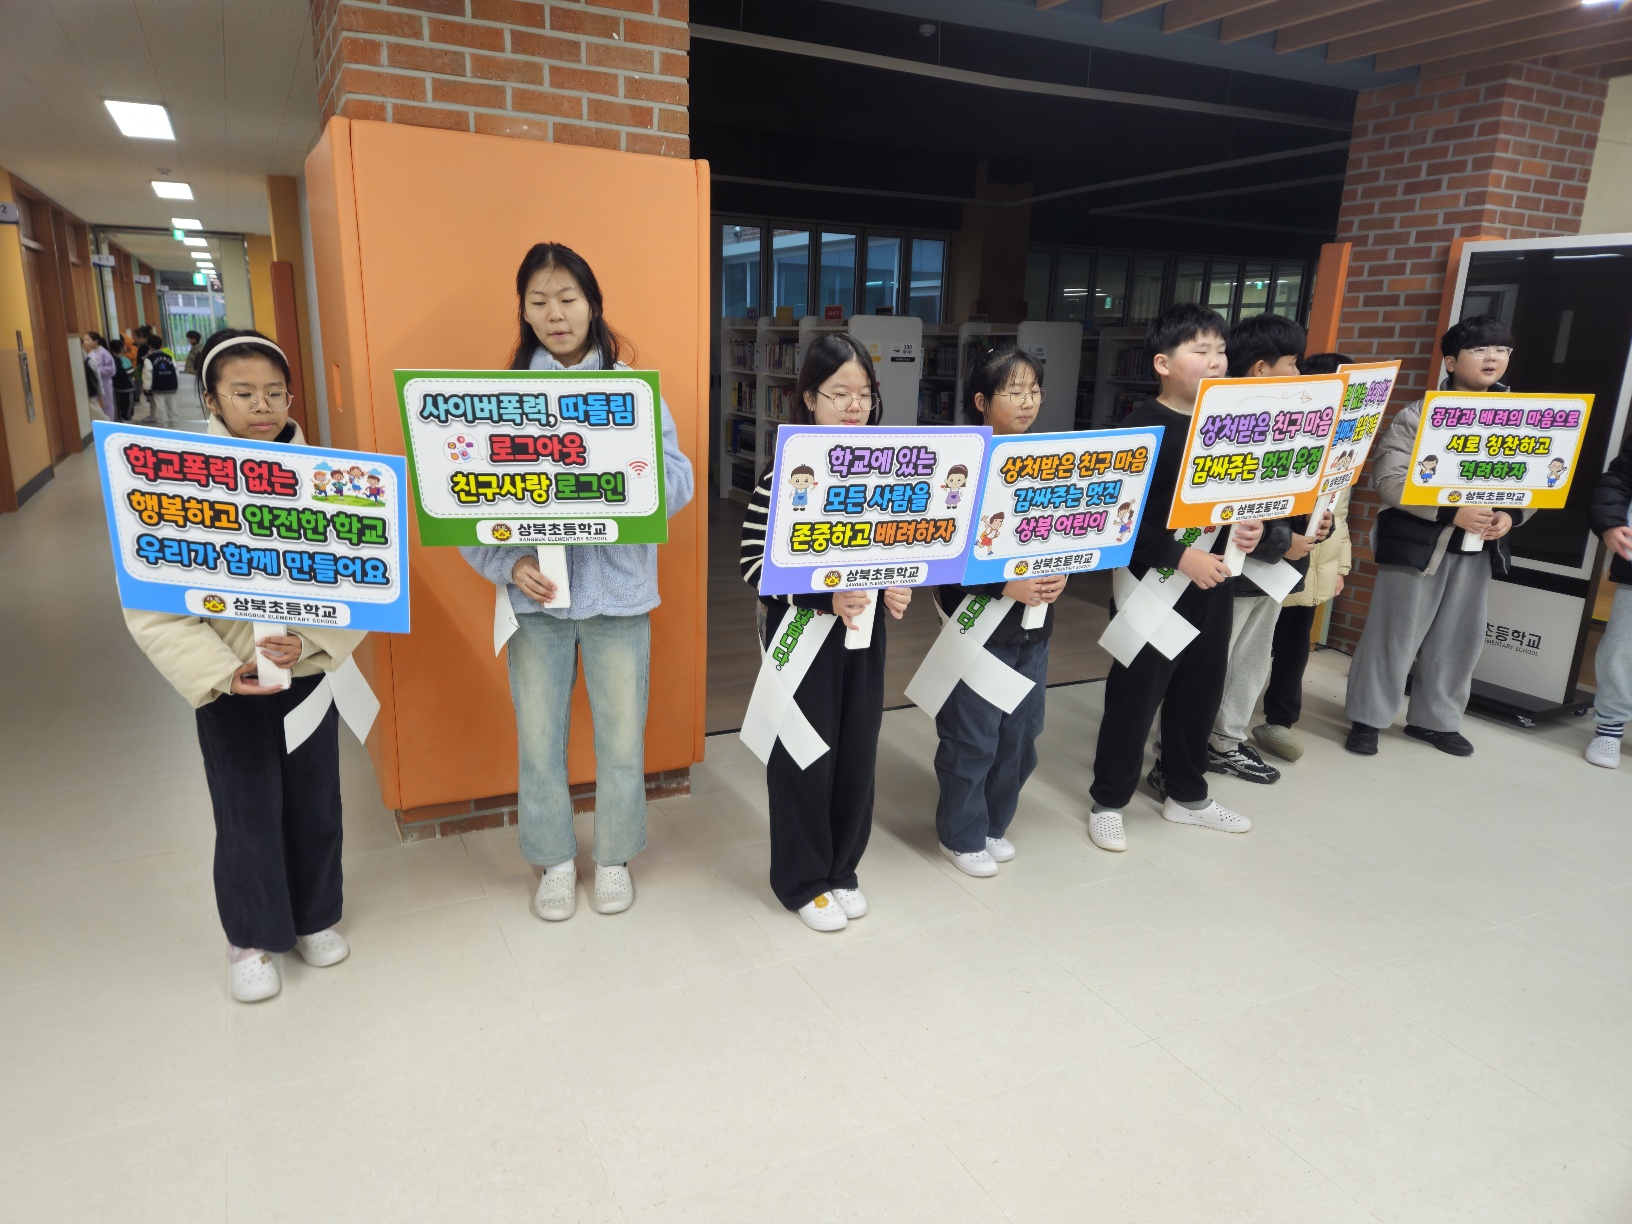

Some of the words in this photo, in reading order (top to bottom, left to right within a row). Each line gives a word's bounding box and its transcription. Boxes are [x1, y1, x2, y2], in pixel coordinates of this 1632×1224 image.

[420, 393, 557, 428] 사이버폭력,
[558, 393, 636, 427] 따돌림
[1200, 411, 1271, 447] 상처받은
[1272, 410, 1304, 441] 친구
[1303, 406, 1334, 437] 마음
[1431, 407, 1477, 427] 공감과
[1478, 408, 1524, 426] 배려의
[1525, 408, 1581, 429] 마음으로
[489, 432, 586, 466] 로그아웃
[829, 445, 895, 477] 학교에
[895, 446, 937, 477] 있는
[1446, 435, 1482, 453] 서로
[1485, 434, 1552, 457] 칭찬하고
[124, 444, 237, 490] 학교폭력
[240, 458, 299, 496] 없는
[1000, 452, 1075, 484] 상처받은
[1078, 451, 1113, 478] 친구
[1113, 446, 1149, 472] 마음
[1192, 452, 1259, 485] 감싸주는
[1261, 448, 1295, 480] 멋진
[1292, 445, 1324, 475] 우정
[1459, 460, 1527, 481] 격려하자
[451, 471, 551, 504] 친구사랑
[554, 472, 627, 502] 로그인
[823, 484, 867, 514] 모든
[868, 481, 932, 513] 사람을
[1014, 484, 1084, 514] 감싸주는
[1085, 479, 1123, 507] 멋진
[1466, 491, 1525, 502] 상북초등학교
[127, 490, 241, 530] 행복하고
[242, 504, 328, 541] 안전한
[331, 512, 389, 545] 학교
[1237, 499, 1289, 516] 상북초등학교
[518, 522, 607, 536] 상북초등학교
[791, 521, 873, 554] 존중하고
[873, 518, 956, 546] 배려하자
[1015, 514, 1054, 543] 상북
[1054, 510, 1108, 538] 어린이
[137, 533, 221, 569] 우리가
[221, 542, 280, 575] 함께
[283, 552, 390, 586] 만들어요
[847, 566, 919, 582] 상북초등학교
[1033, 553, 1093, 570] 상북초등학교
[233, 597, 337, 619] 상북초등학교
[234, 611, 266, 619] SANGBUK
[268, 614, 310, 623] ELEMENTARY
[1515, 646, 1538, 656] SCHOOL
